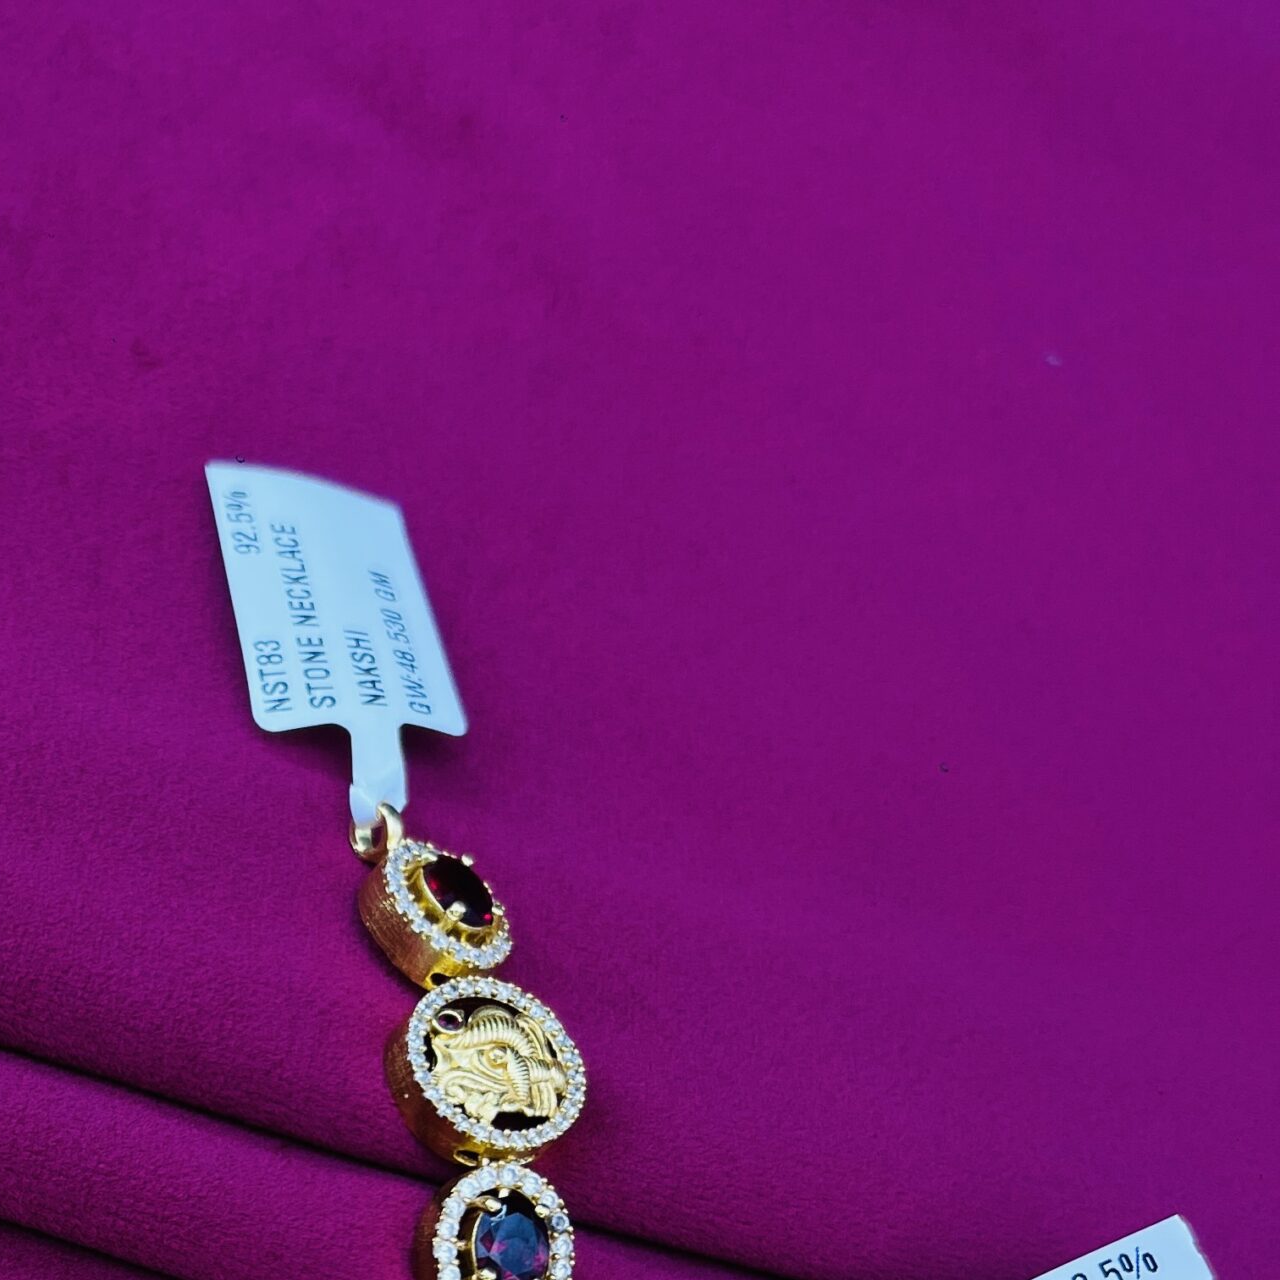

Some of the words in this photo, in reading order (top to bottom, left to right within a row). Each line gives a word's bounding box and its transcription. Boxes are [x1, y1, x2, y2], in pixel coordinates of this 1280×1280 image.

[223, 490, 260, 555] 92.5%
[271, 523, 320, 626] NECKLACE
[368, 571, 396, 601] GM
[254, 640, 293, 713] NST83
[297, 637, 336, 709] STONE
[343, 630, 388, 707] NAKSHI
